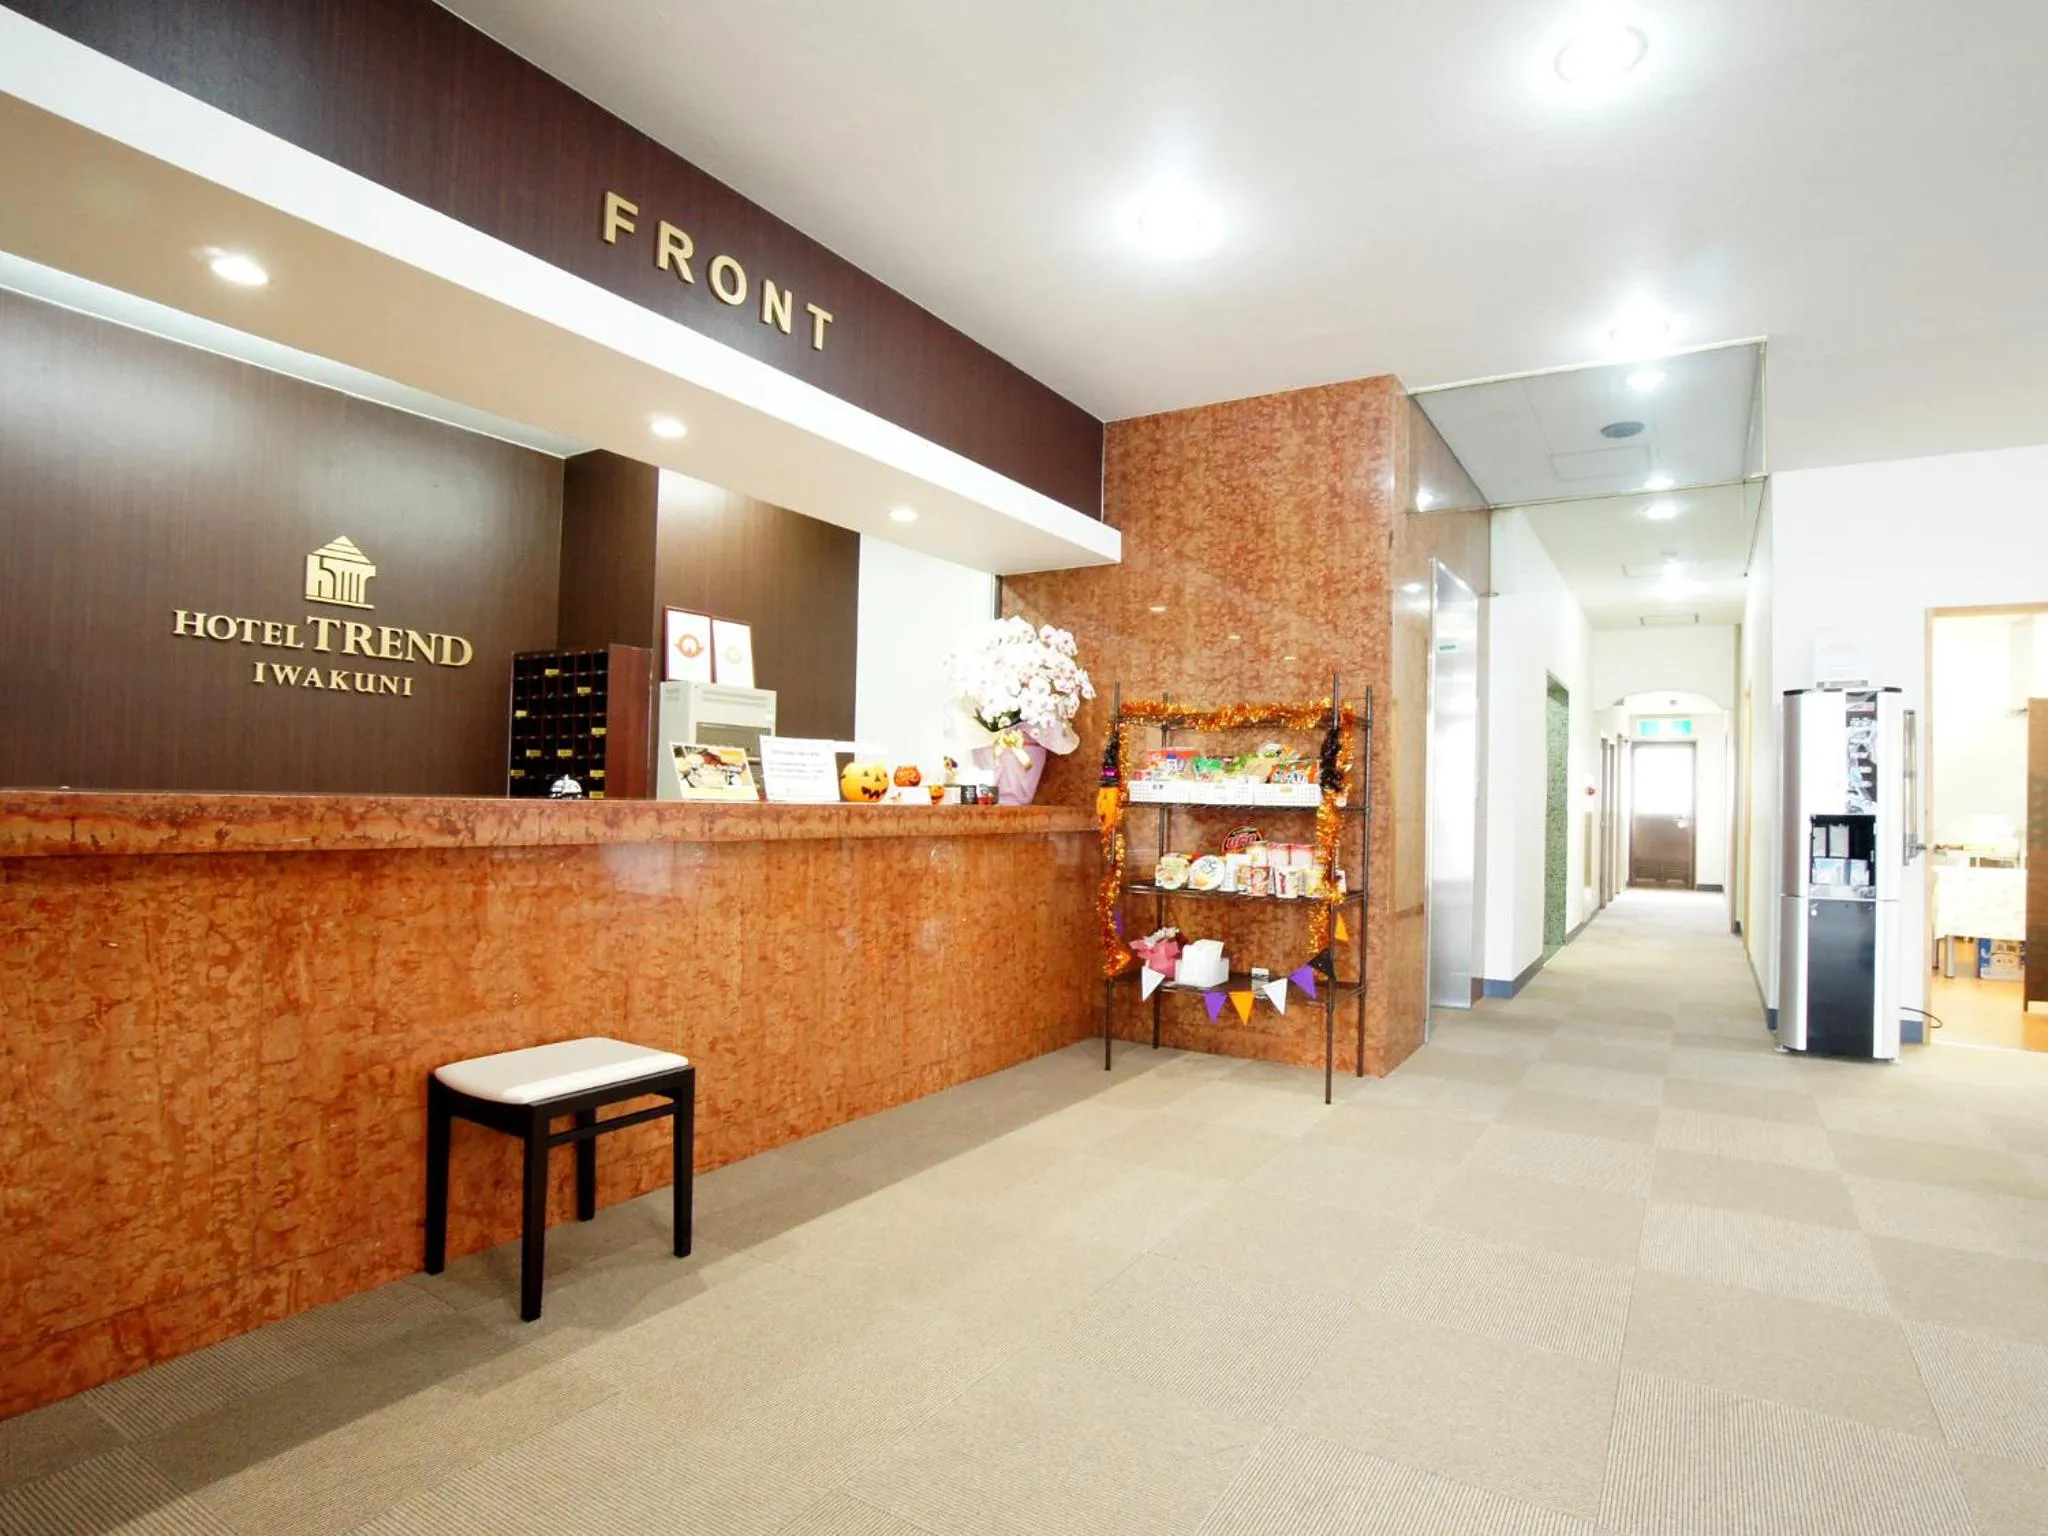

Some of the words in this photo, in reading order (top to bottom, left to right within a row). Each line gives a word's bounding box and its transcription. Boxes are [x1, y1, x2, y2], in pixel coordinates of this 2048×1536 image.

[603, 190, 834, 351] FRONT
[172, 609, 304, 649] HOTEL
[306, 615, 473, 668] TREND
[252, 661, 414, 697] IWAKUNI
